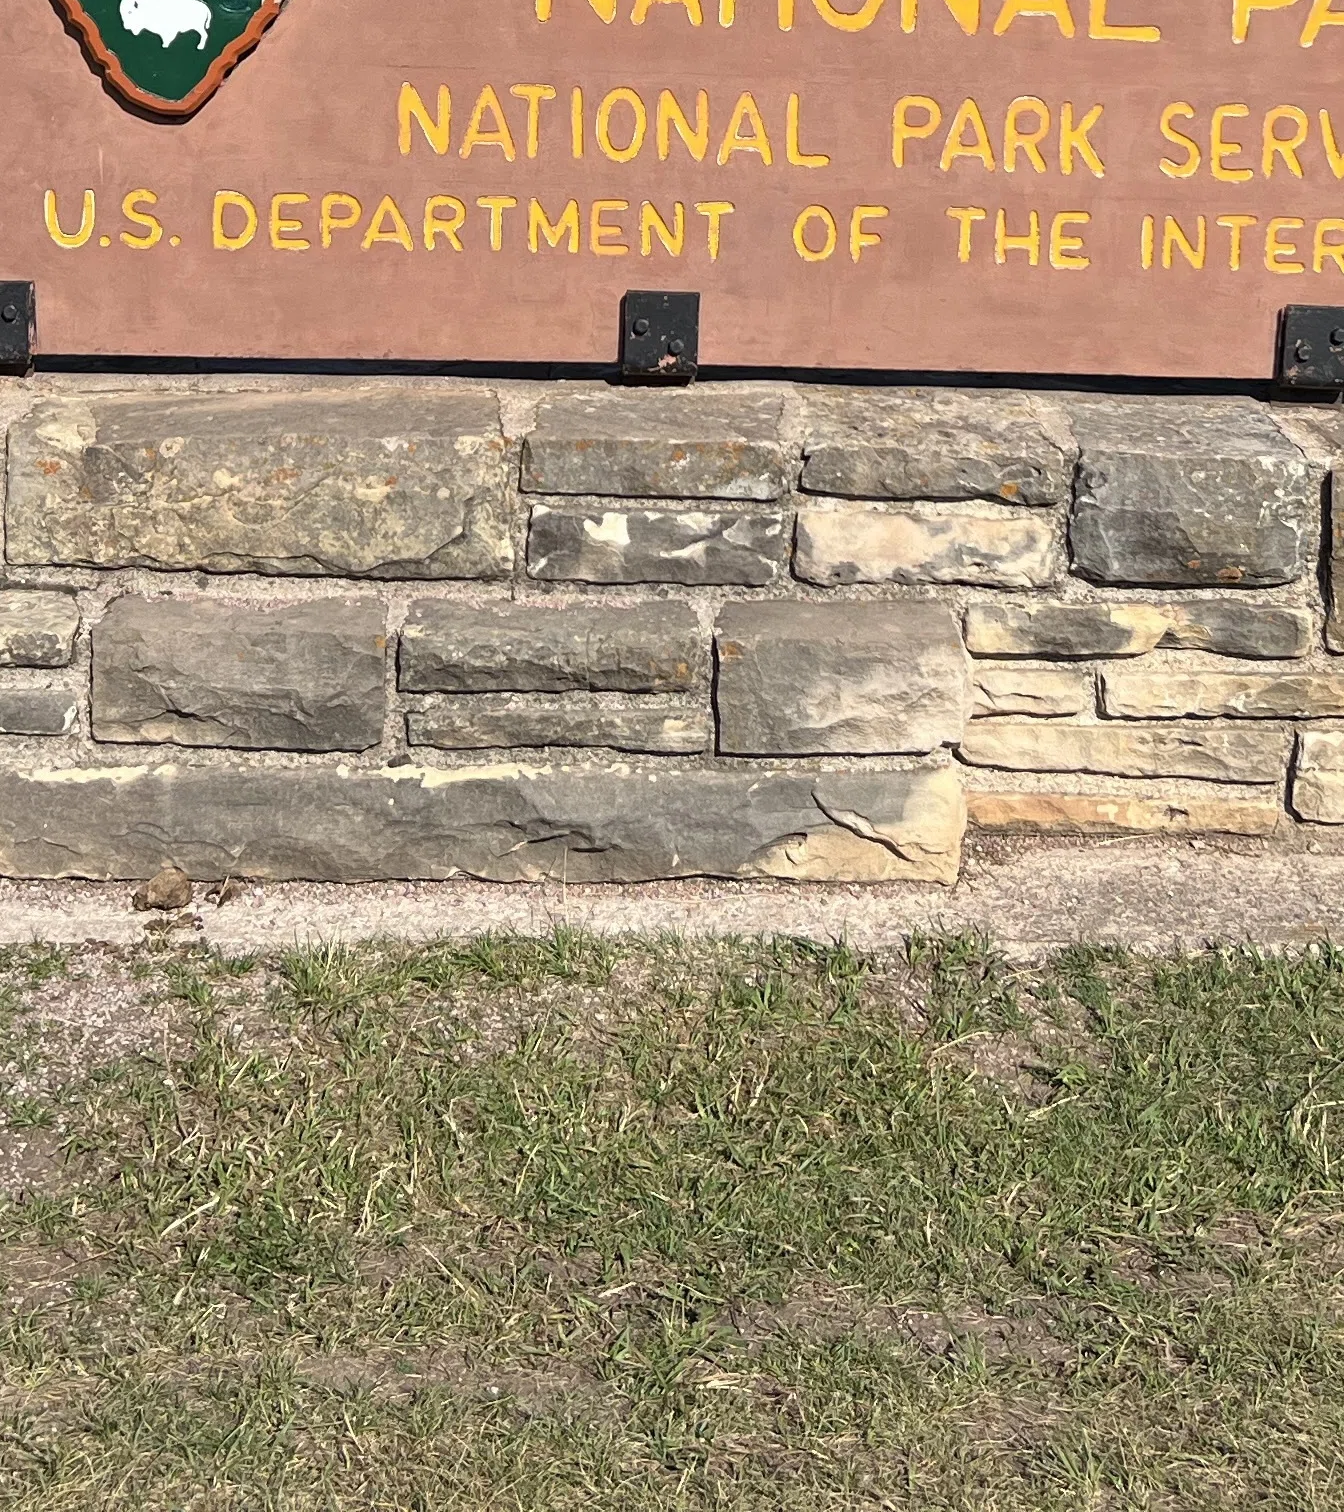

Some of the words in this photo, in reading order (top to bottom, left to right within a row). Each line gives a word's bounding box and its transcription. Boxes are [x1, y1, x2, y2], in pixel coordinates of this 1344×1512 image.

[397, 81, 832, 169] NATIONAL
[891, 94, 1106, 180] PARK
[42, 188, 182, 250] U.S.
[211, 190, 737, 261] DEPARTMENT
[791, 204, 890, 264] OF
[947, 206, 1092, 271] THE
